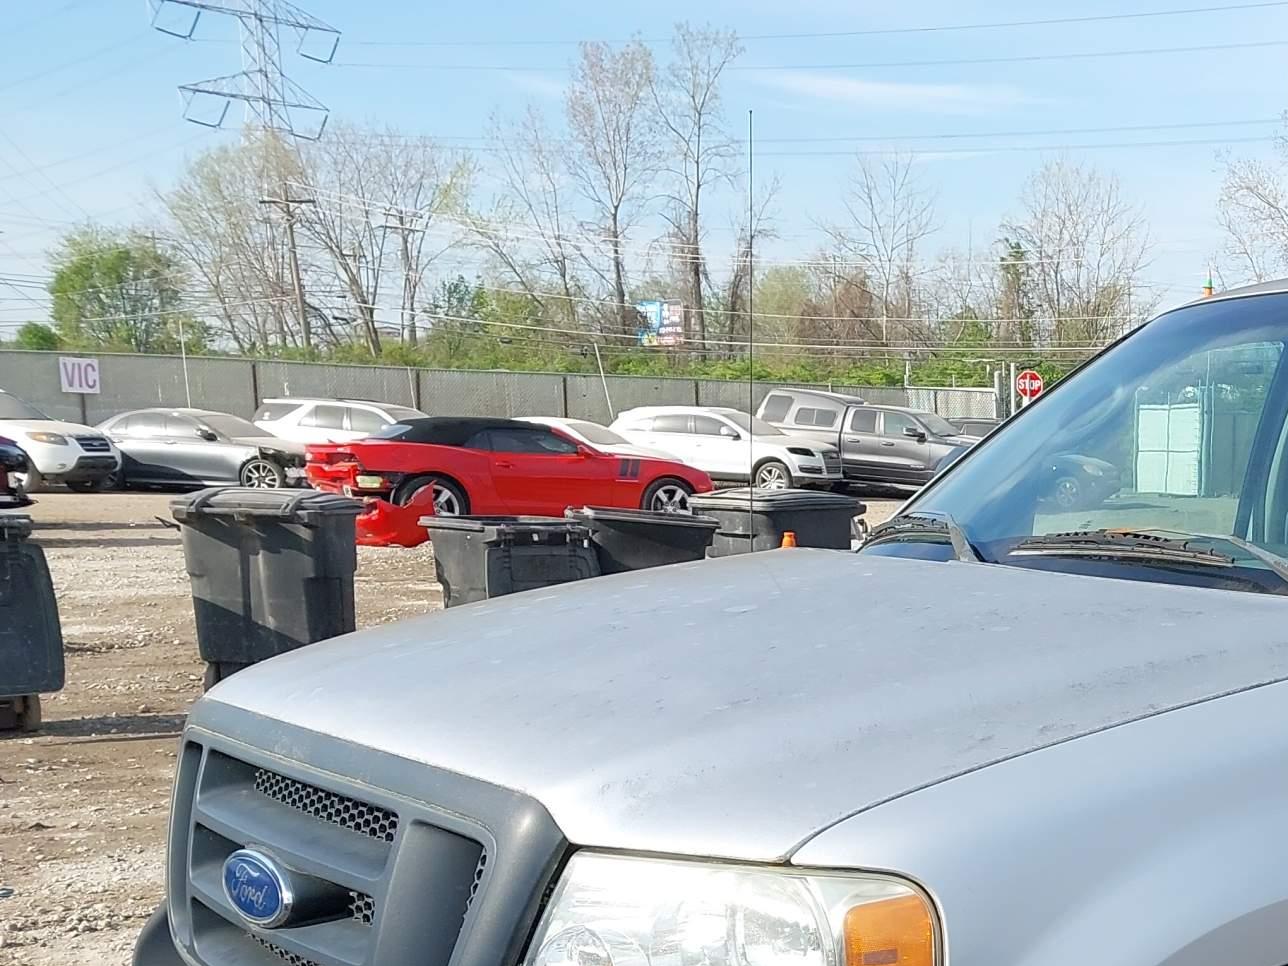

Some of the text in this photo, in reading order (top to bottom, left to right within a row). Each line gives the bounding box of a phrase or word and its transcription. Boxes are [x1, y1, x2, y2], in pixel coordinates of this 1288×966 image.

[62, 362, 96, 389] VIC
[1018, 379, 1041, 390] STOP
[231, 863, 268, 910] Ford
